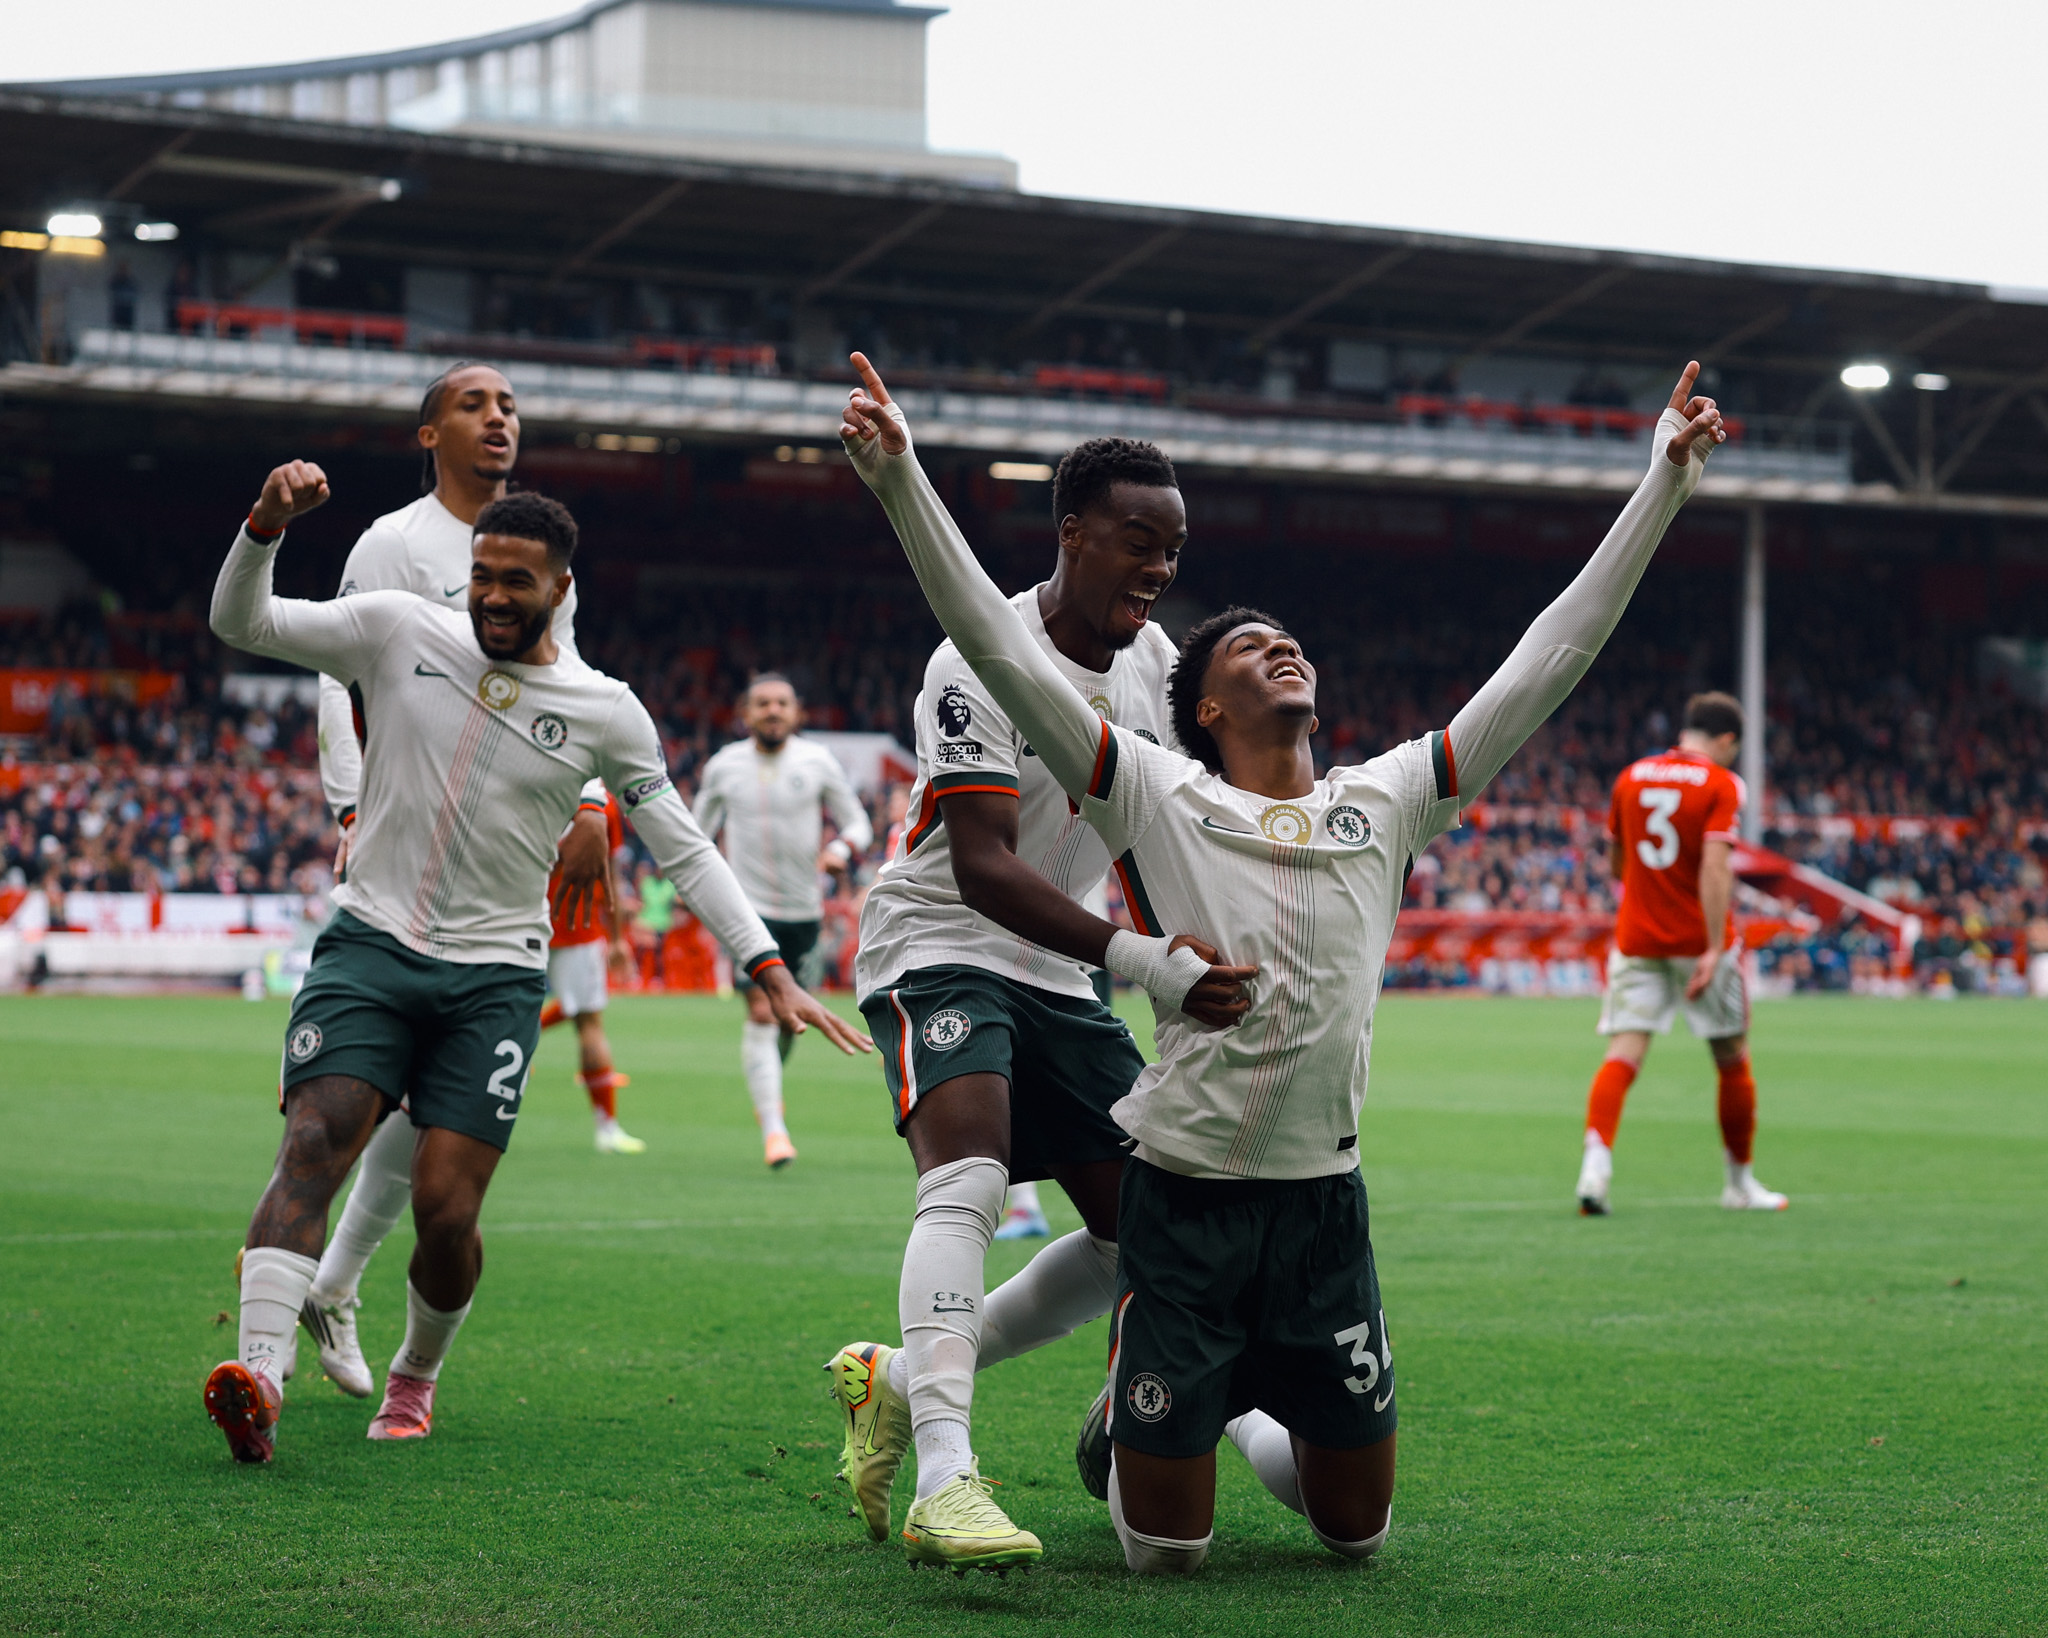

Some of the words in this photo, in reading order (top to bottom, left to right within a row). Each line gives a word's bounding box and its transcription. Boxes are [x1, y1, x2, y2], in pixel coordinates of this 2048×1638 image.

[937, 744, 949, 755] No
[949, 744, 977, 754] room
[949, 753, 983, 763] racism
[1328, 806, 1355, 821] CHELSEA
[1264, 812, 1276, 836] WORLD
[1275, 808, 1308, 833] CHAMPIONS
[1637, 787, 1682, 870] 3
[930, 1011, 960, 1024] CHELSEA
[1136, 1374, 1164, 1388] CHELSEA
